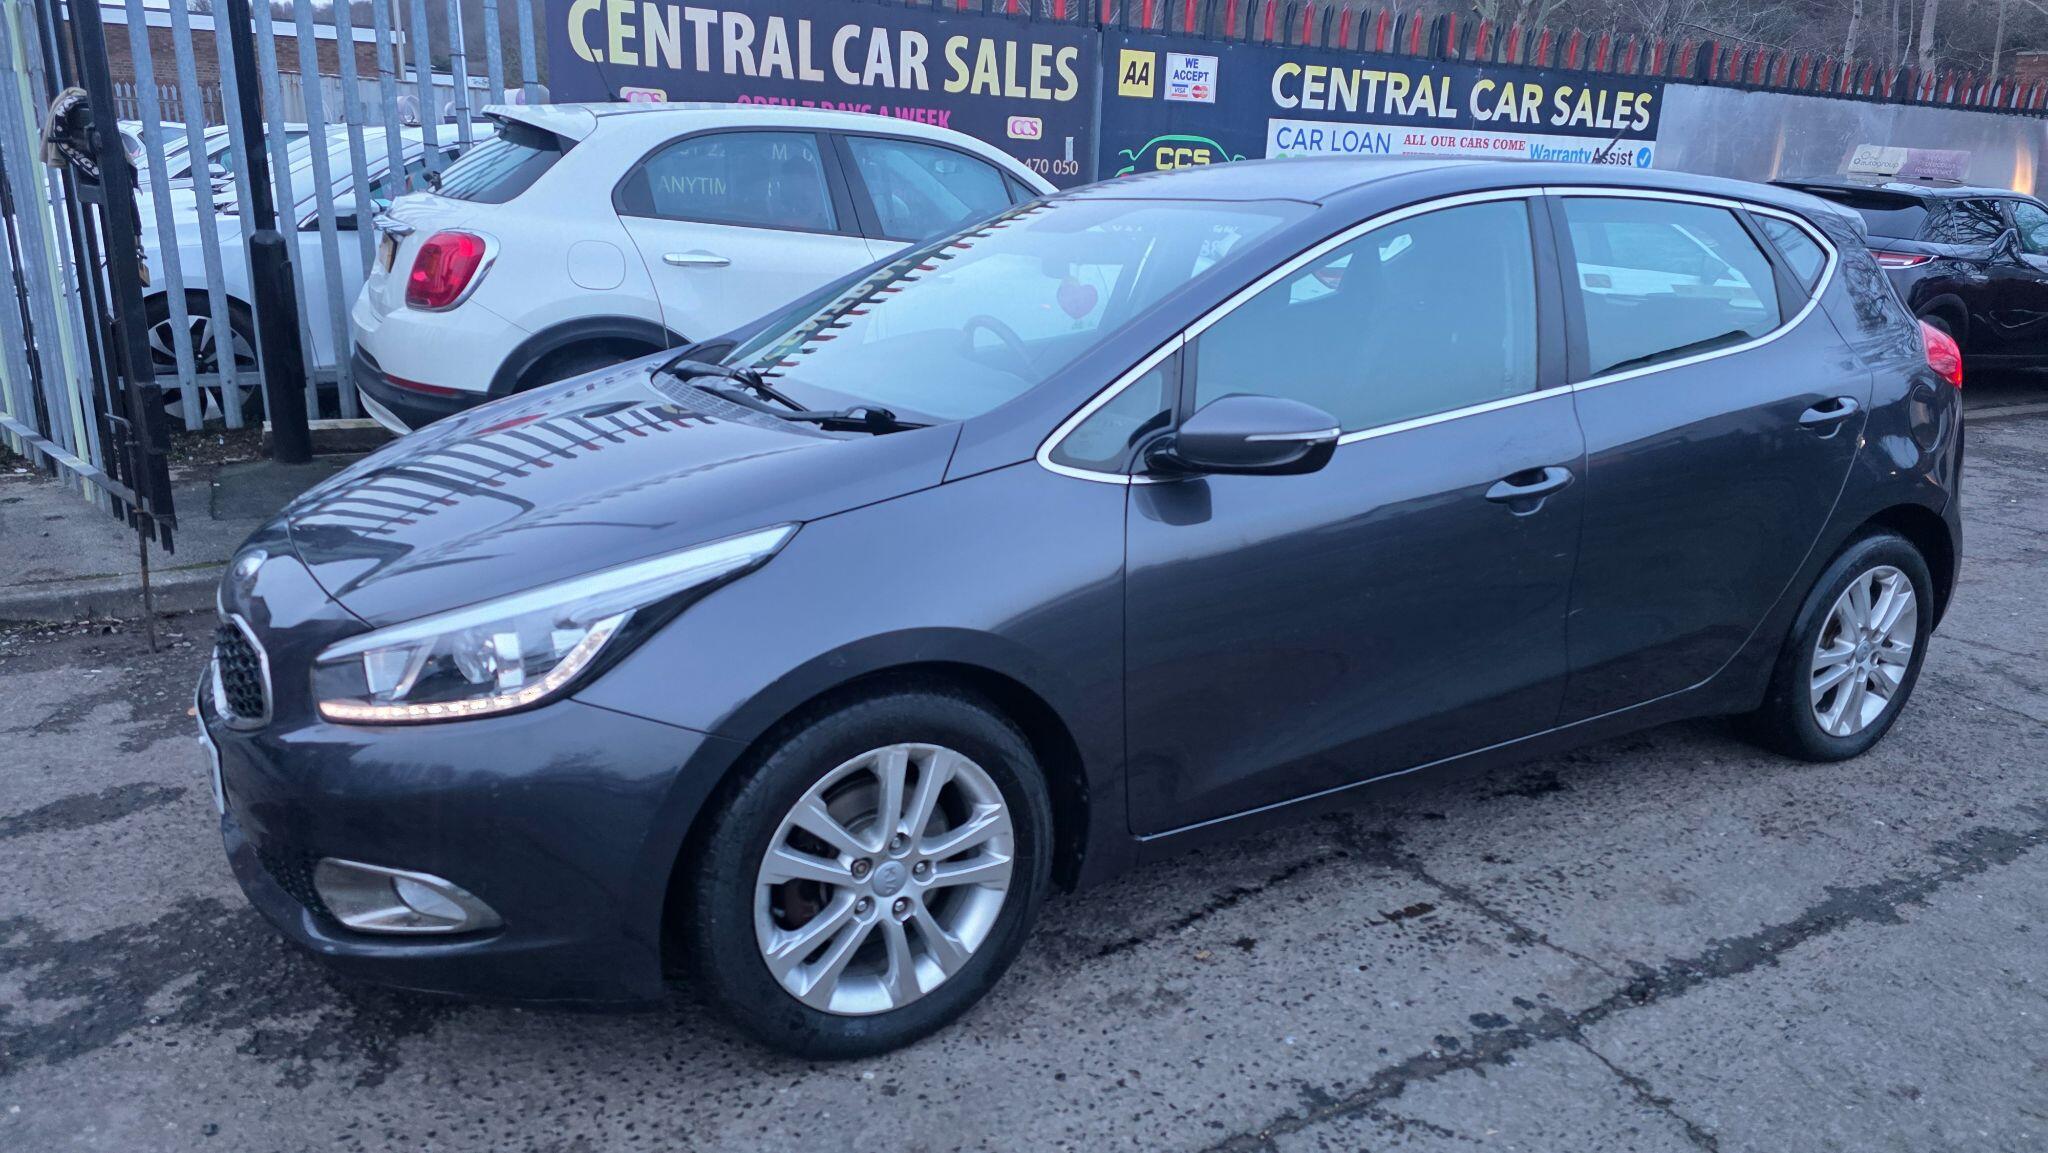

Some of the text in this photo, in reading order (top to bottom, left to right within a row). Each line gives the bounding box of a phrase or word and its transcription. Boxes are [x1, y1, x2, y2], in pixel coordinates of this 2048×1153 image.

[567, 0, 1079, 101] CENTRAL CAR SALES
[1185, 57, 1200, 69] WE
[1123, 61, 1150, 86] AA
[1172, 69, 1210, 82] ACCEPT
[1271, 62, 1653, 131] CENTRAL CAR SALES
[1276, 126, 1392, 154] CAR LOAN
[1403, 133, 1527, 151] ALL OUR CARS COME
[1155, 146, 1211, 171] CCS
